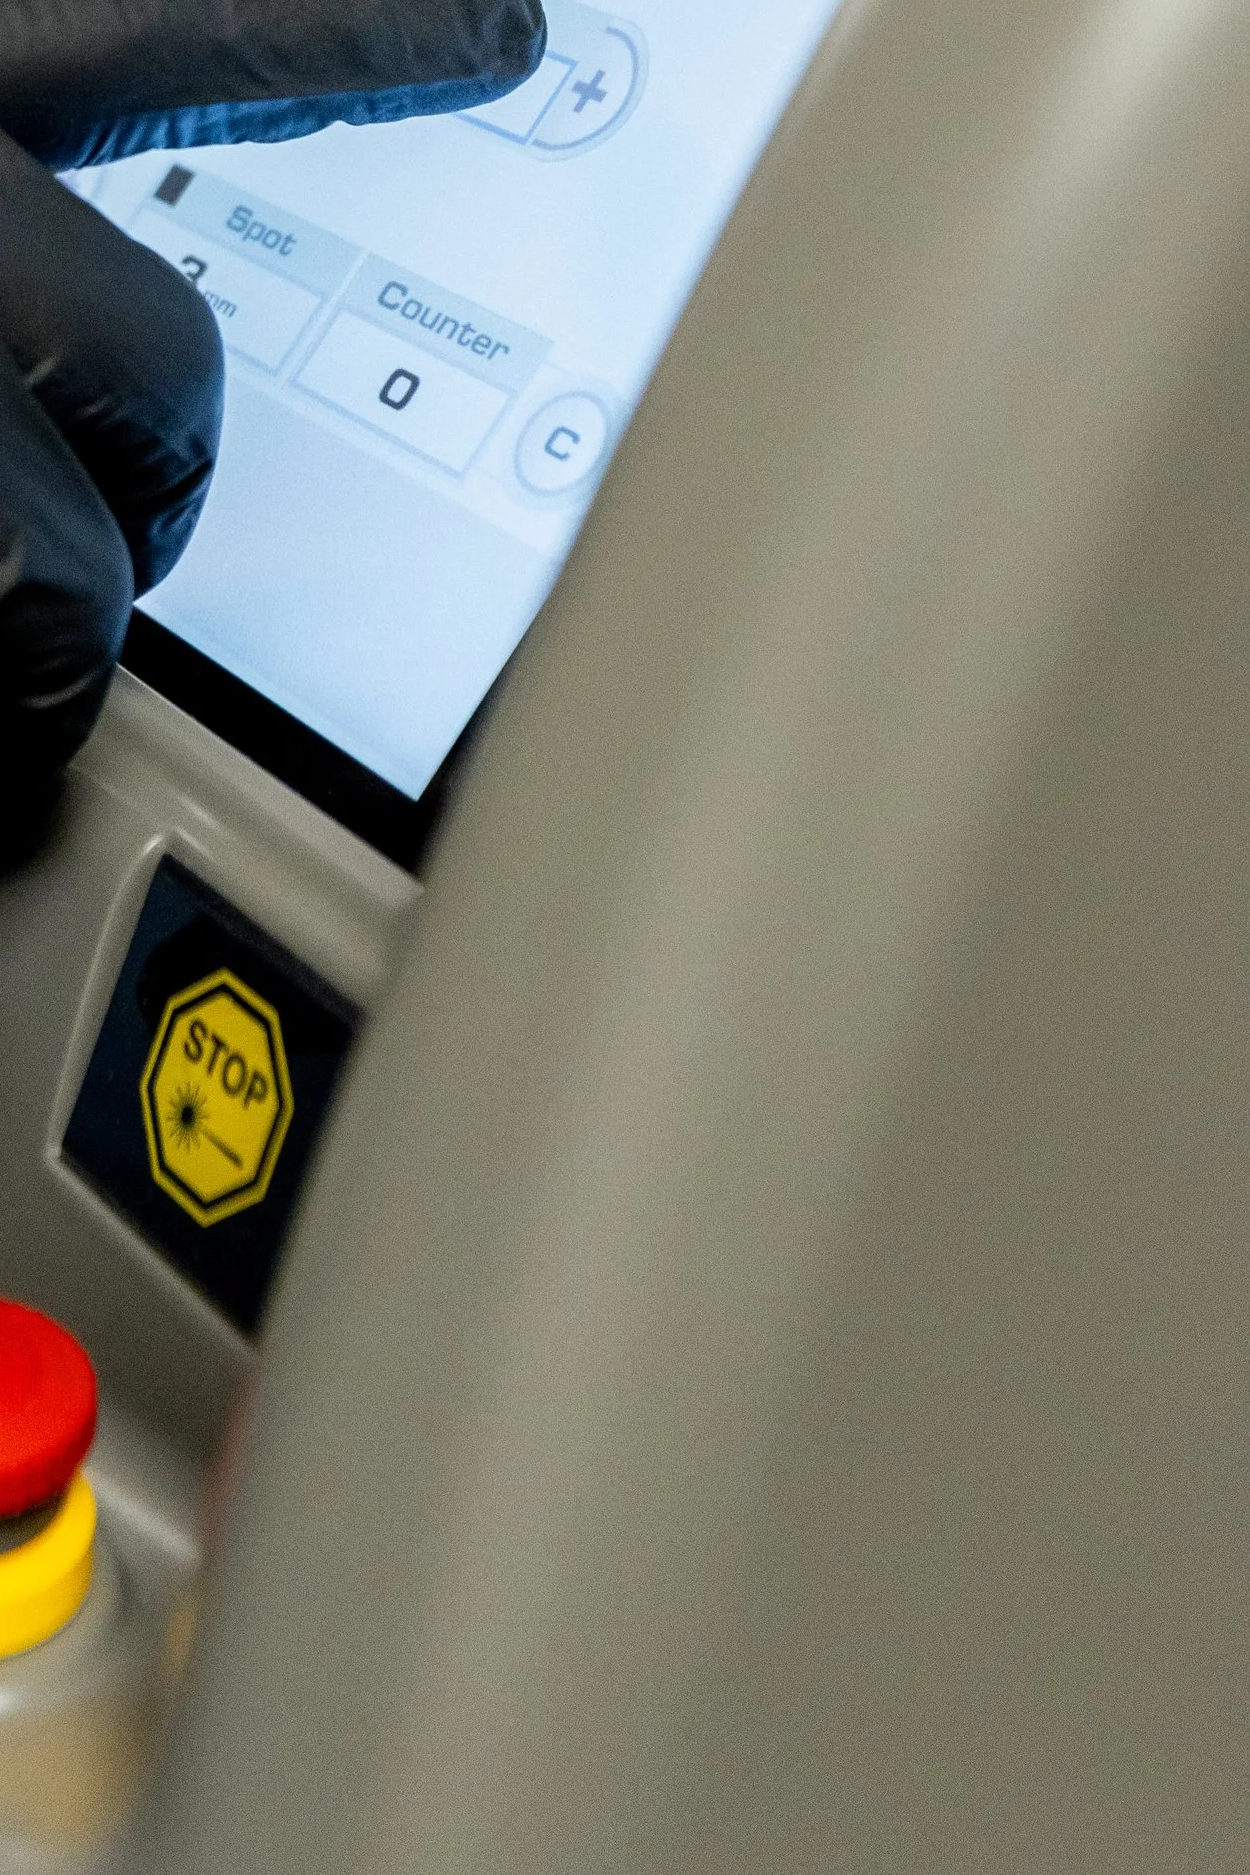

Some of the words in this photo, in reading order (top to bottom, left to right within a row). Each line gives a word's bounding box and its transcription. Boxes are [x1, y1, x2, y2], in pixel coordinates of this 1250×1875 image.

[225, 204, 298, 257] Spot
[376, 280, 511, 361] Counter
[378, 368, 421, 411] 0
[544, 424, 582, 463] C
[182, 1019, 269, 1111] STOP
